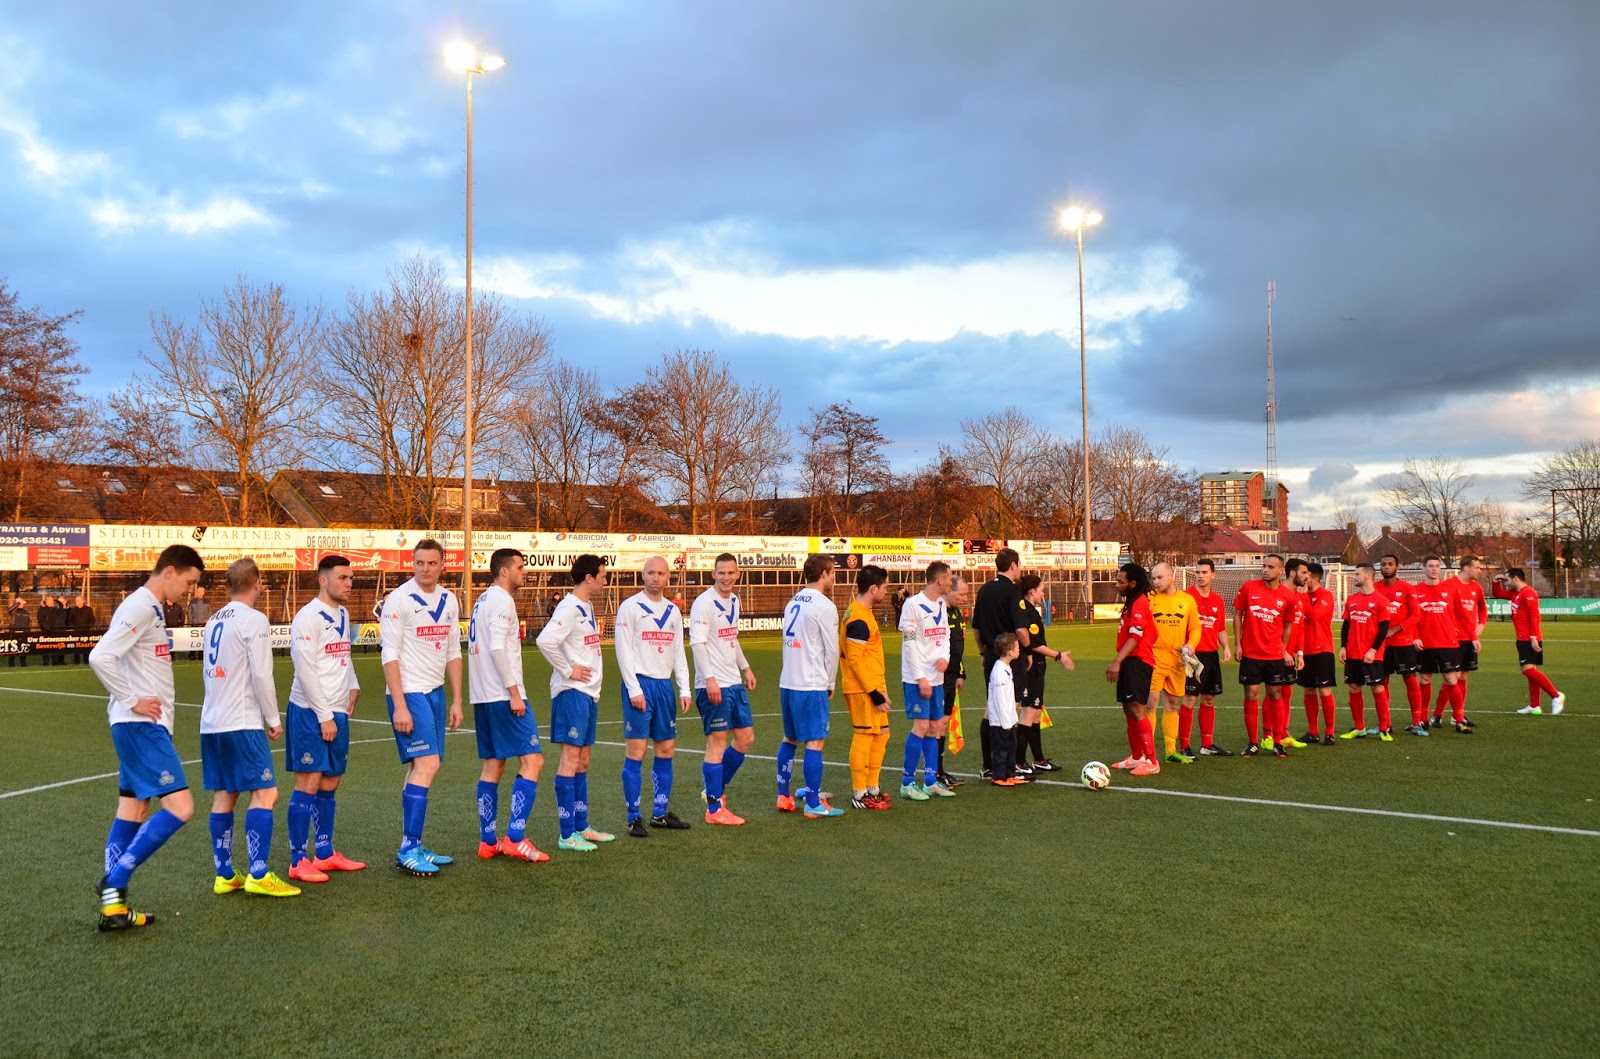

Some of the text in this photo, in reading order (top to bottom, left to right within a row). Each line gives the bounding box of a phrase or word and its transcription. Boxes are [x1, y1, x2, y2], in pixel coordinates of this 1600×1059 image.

[51, 526, 87, 534] ADVIES
[98, 527, 291, 540] STIGHTER & PARTNERS
[0, 537, 66, 545] 020-6365421
[306, 536, 351, 548] DE GROOT BV
[218, 552, 243, 560] kwaliteit
[350, 552, 382, 568] anck
[737, 553, 797, 567] Leo Dauphin
[977, 556, 996, 564] Drukk
[1062, 556, 1084, 564] Master
[795, 595, 812, 603] UKO.
[785, 604, 801, 637] 2
[39, 635, 79, 643] fietsenmaker
[209, 621, 224, 666] 9
